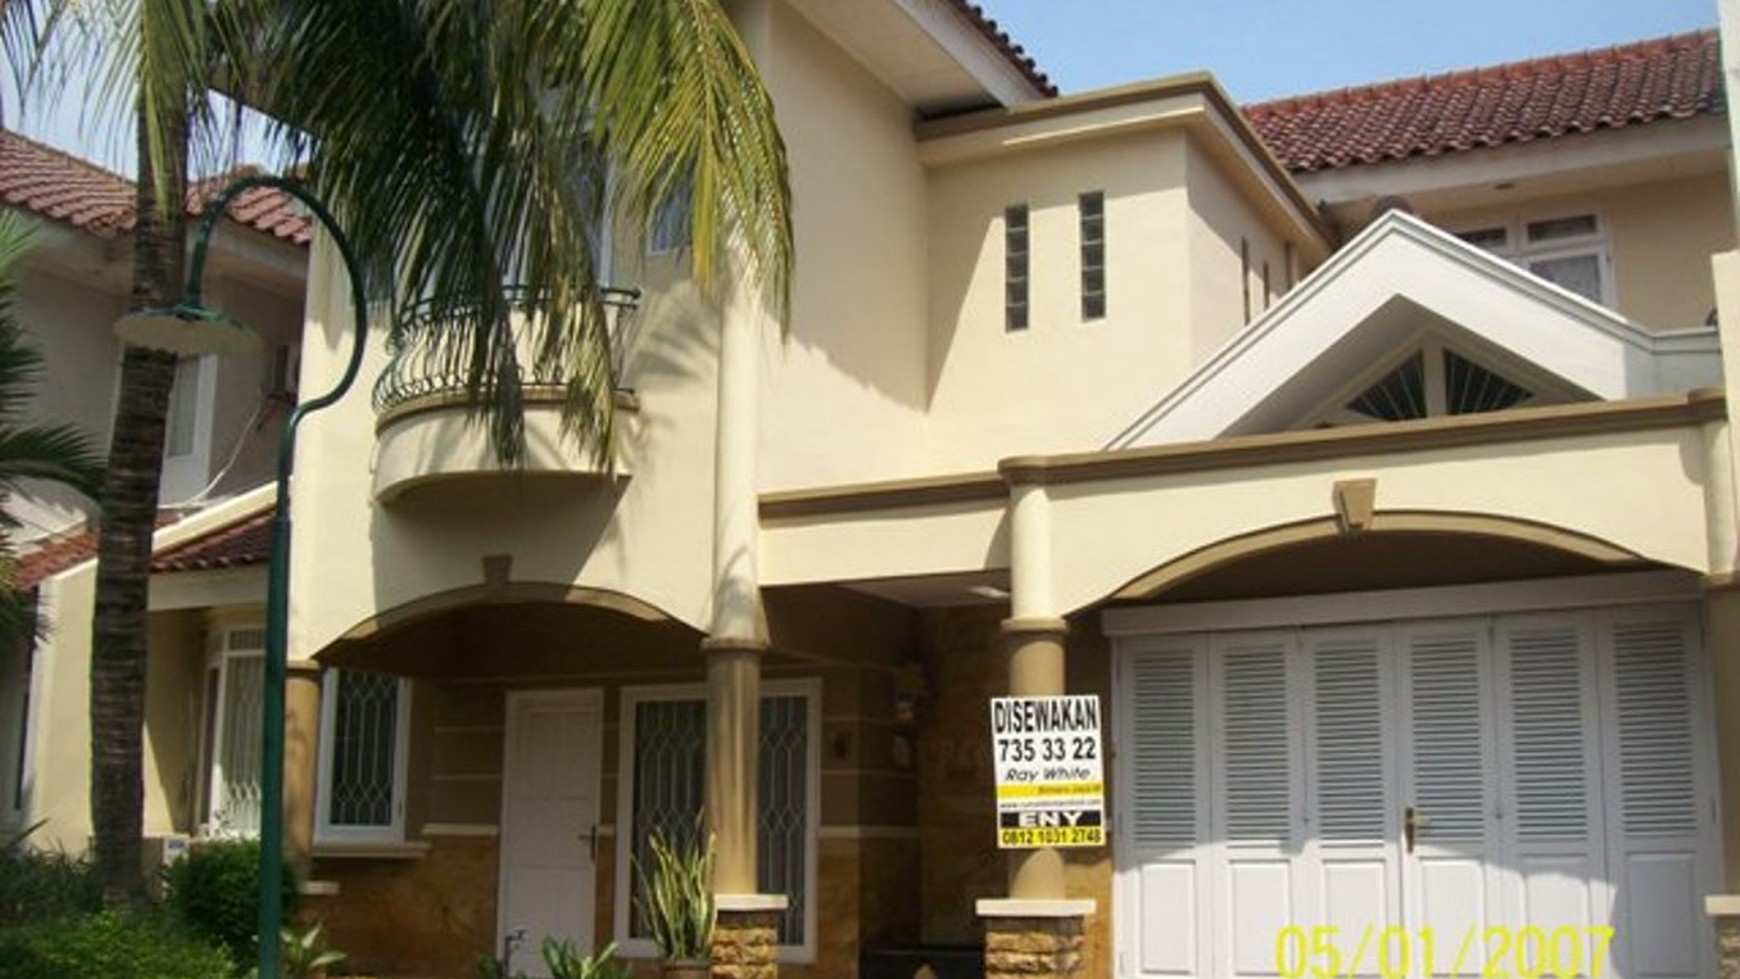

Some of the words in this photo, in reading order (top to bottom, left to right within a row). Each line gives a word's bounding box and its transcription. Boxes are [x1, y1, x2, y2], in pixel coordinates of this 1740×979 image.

[995, 699, 1098, 733] DISEWAKAN
[998, 739, 1036, 762] 735
[1042, 738, 1066, 761] 33
[1073, 736, 1096, 759] 22
[1005, 769, 1038, 781] Ray
[1044, 767, 1090, 780] White
[1019, 812, 1083, 827] ENY
[1002, 830, 1034, 844] 0812
